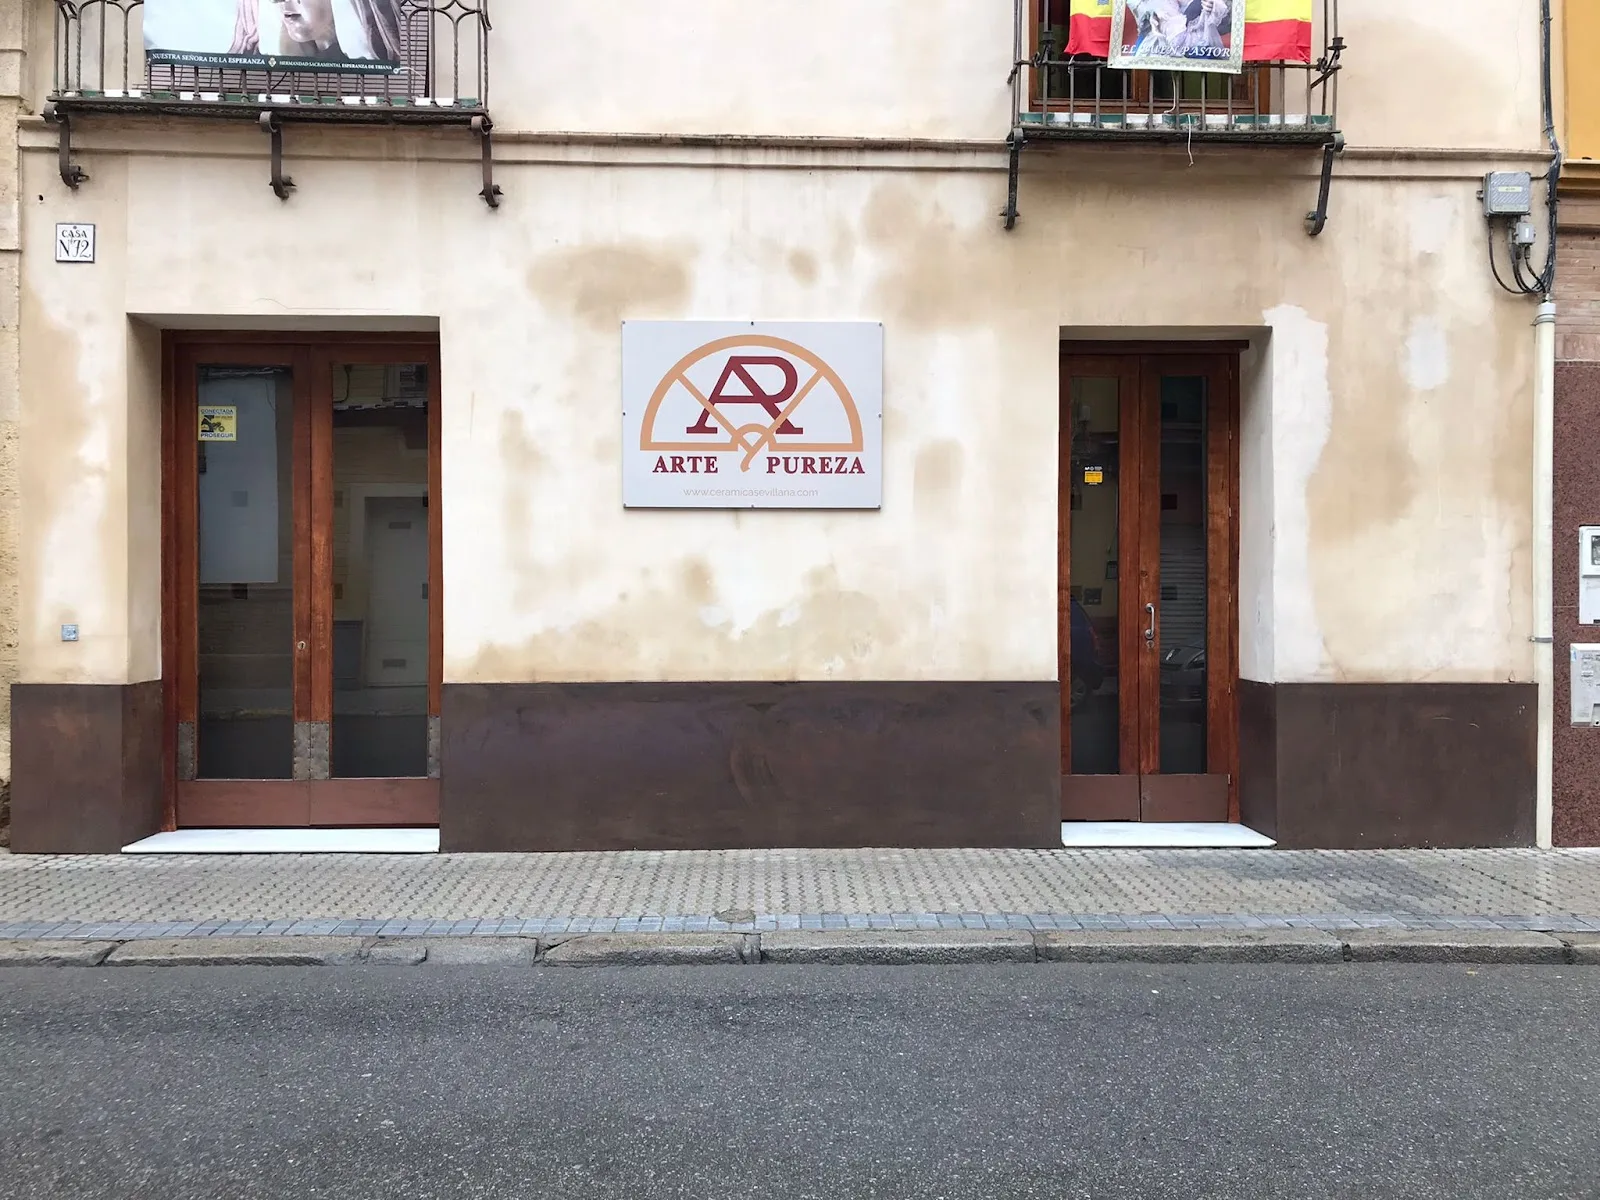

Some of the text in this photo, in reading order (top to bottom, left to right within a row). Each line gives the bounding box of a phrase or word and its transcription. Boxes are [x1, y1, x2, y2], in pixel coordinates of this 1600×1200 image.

[1121, 44, 1137, 54] EL
[1181, 45, 1231, 58] PASTOR
[152, 53, 181, 61] NUESTRA
[228, 57, 266, 65] ESPERANZA
[61, 229, 87, 238] CASA
[652, 455, 866, 475] ARTE PUREZA
[683, 488, 819, 497] www.ceramicasevillana.com
